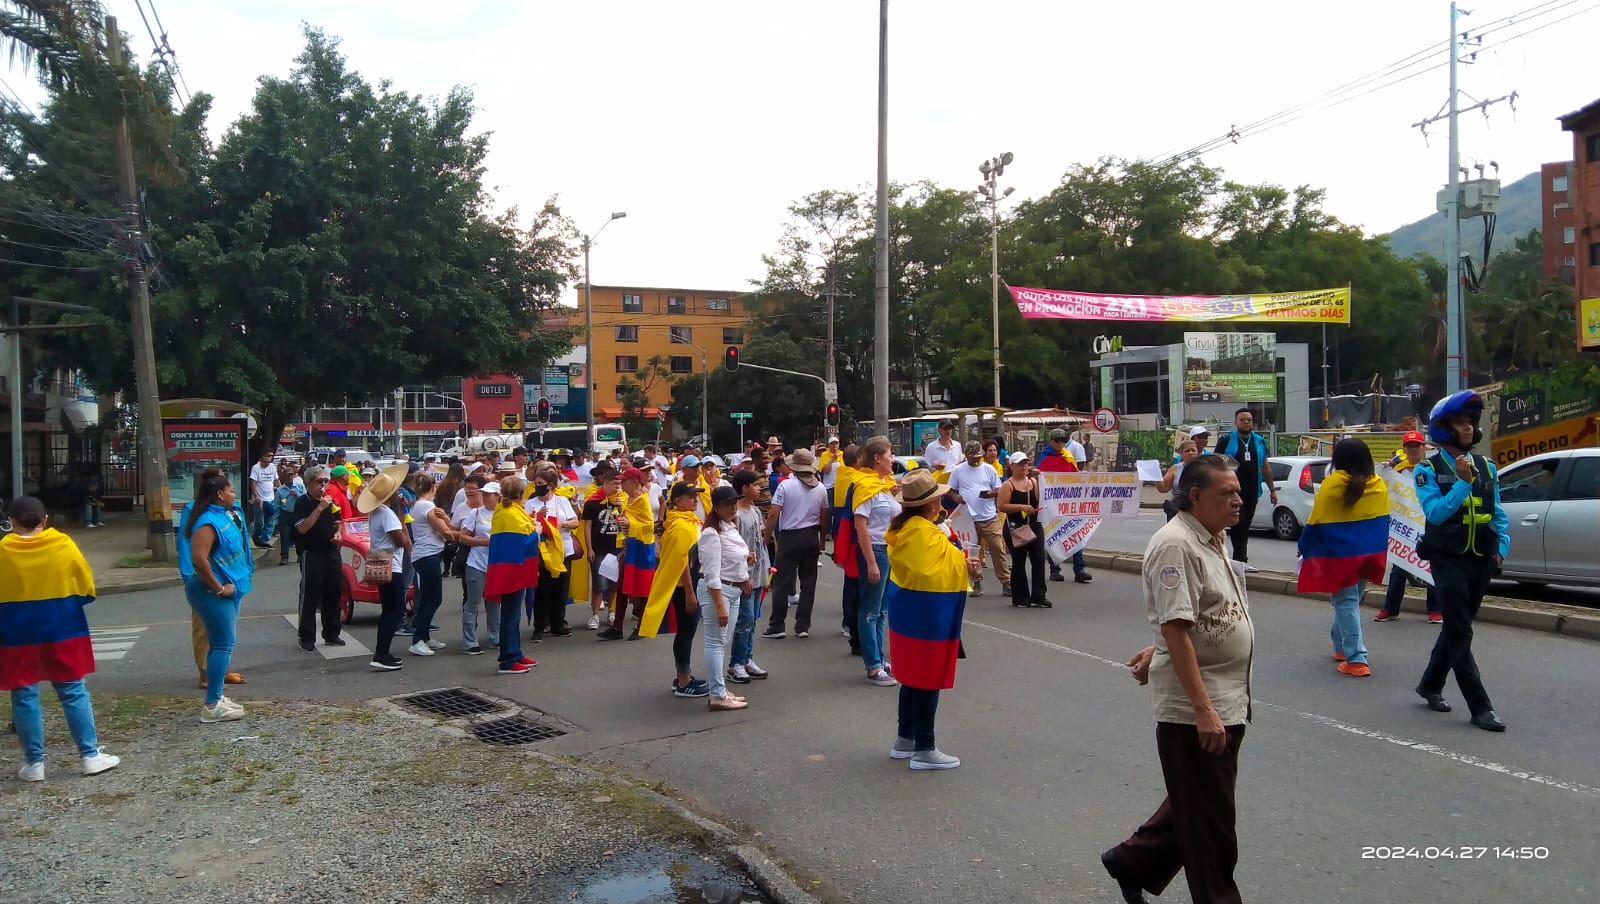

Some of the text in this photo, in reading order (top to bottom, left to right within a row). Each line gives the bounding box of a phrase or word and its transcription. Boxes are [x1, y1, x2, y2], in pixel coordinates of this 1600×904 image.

[1019, 302, 1032, 312] EN
[481, 385, 506, 394] OUTLET
[180, 440, 195, 448] IT'S
[205, 440, 234, 448] CRIME!
[1497, 434, 1569, 465] colmena
[1044, 486, 1082, 501] EXPROPIADOS
[1084, 486, 1090, 497] Y
[1090, 486, 1102, 498] SIN
[1058, 502, 1069, 515] POR
[1071, 502, 1077, 514] EL
[1389, 517, 1414, 538] PIESE
